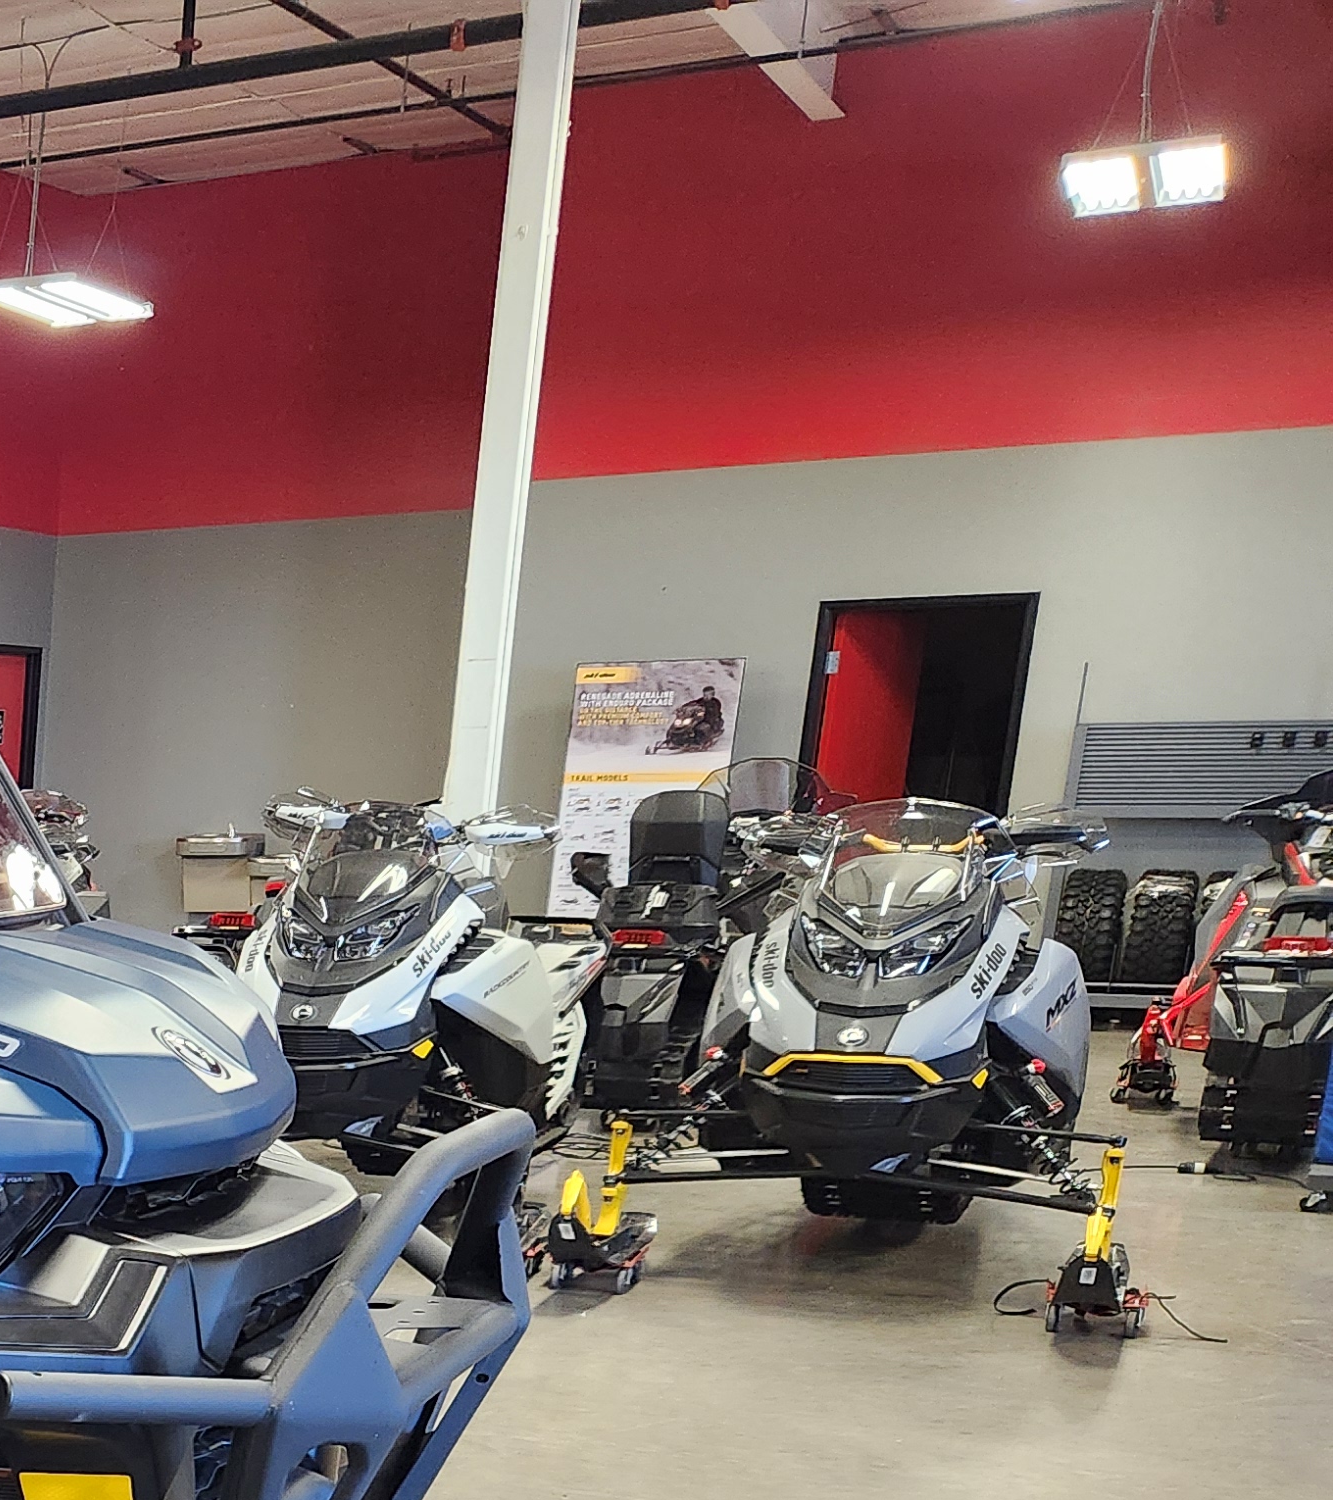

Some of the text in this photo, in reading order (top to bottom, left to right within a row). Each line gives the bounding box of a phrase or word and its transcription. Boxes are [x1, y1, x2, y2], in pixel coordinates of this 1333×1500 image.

[571, 774, 628, 782] TRAIL MODELS
[762, 941, 780, 988] ski-doo
[971, 942, 1007, 1000] ski-doo
[1045, 977, 1077, 1028] MXZ
